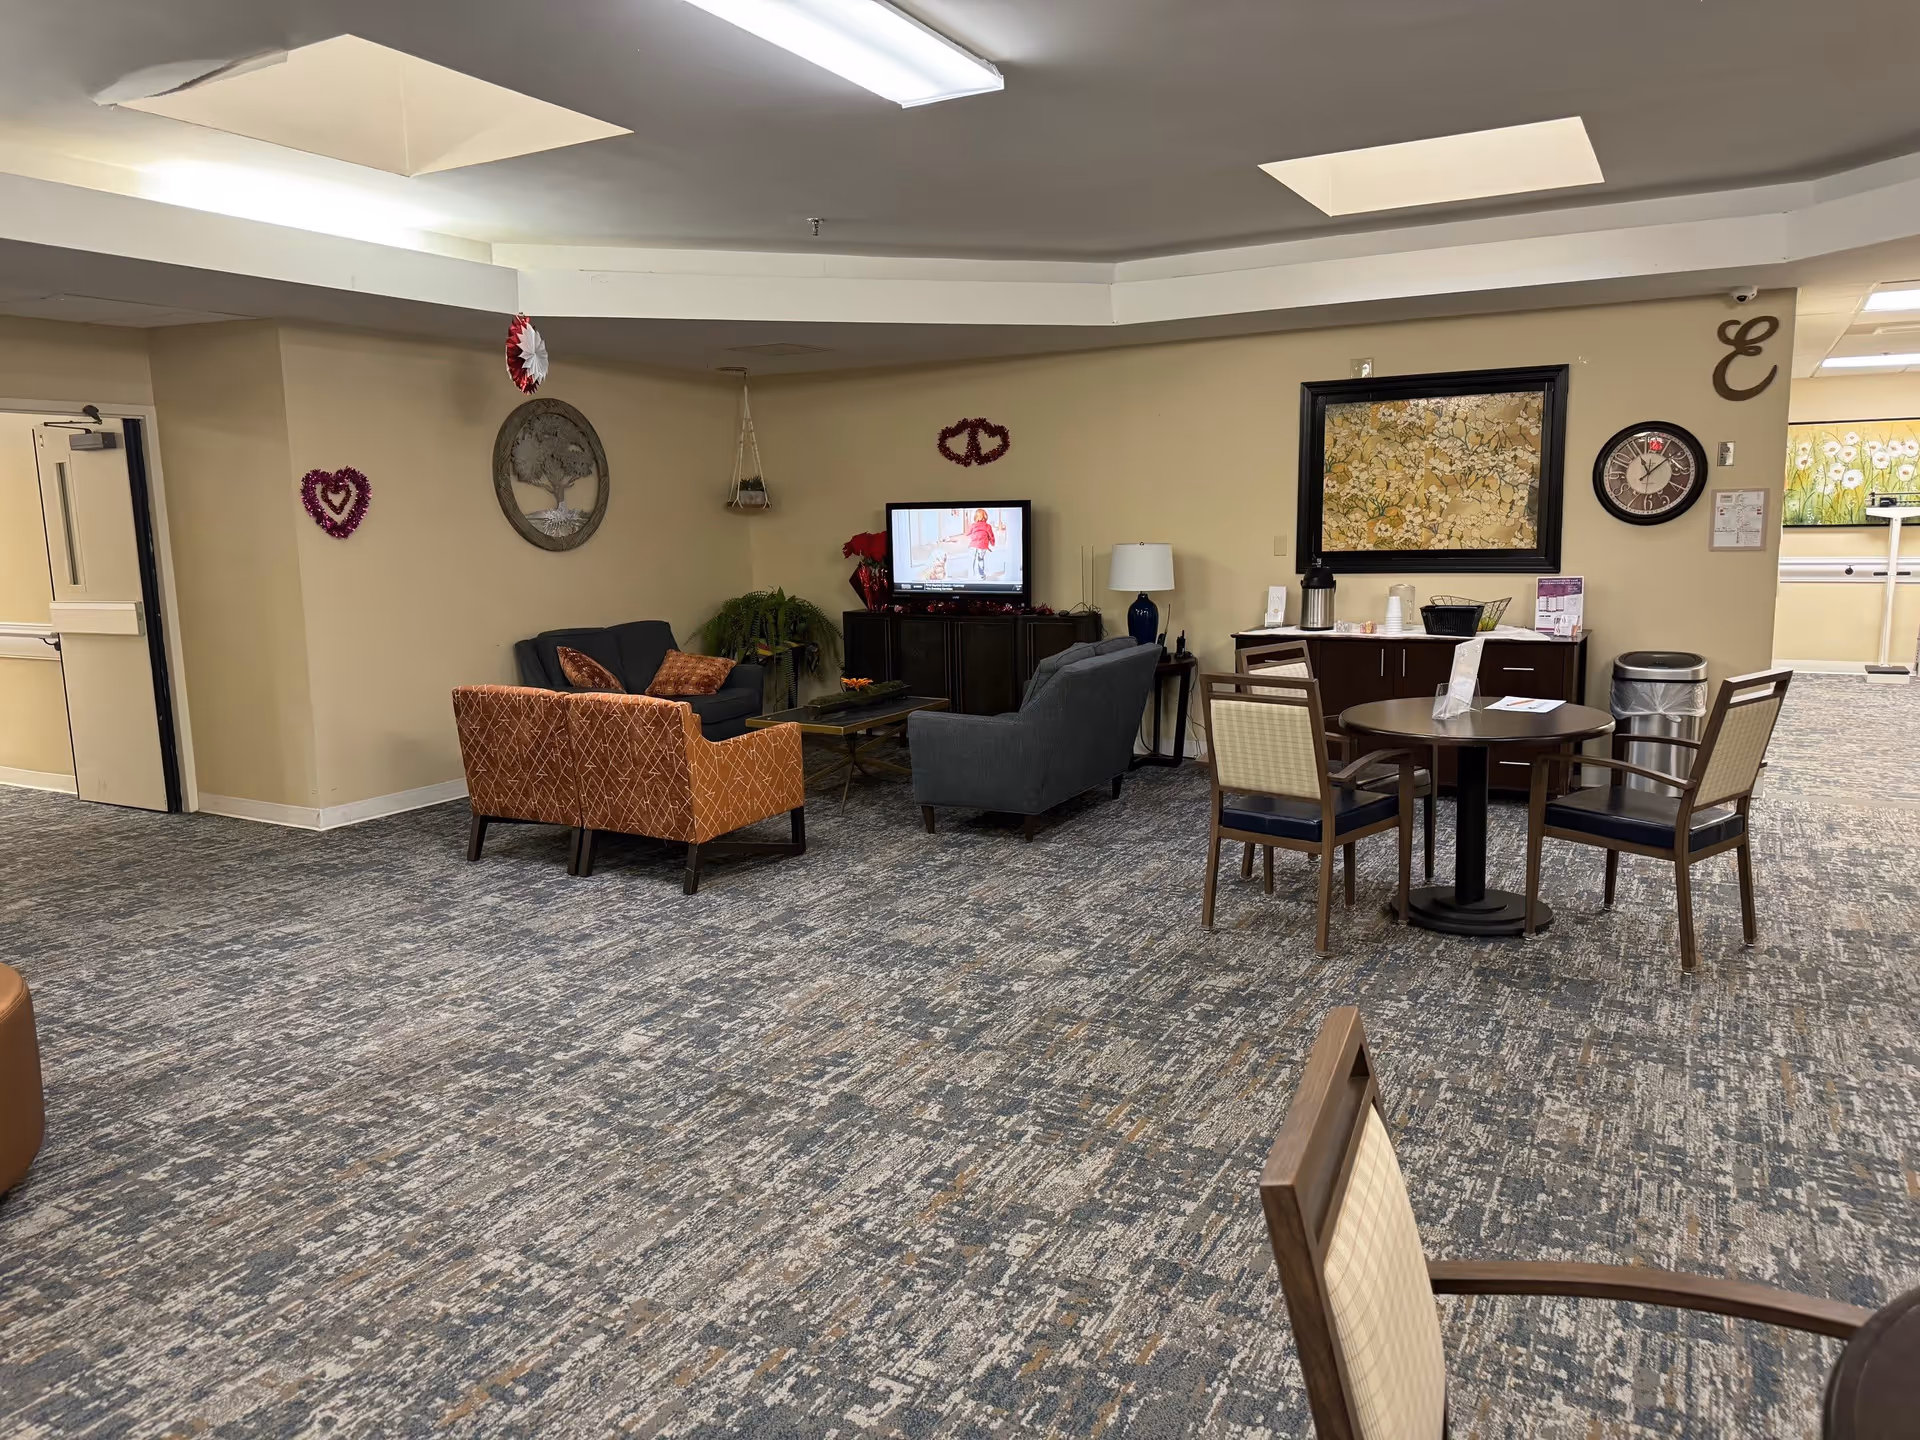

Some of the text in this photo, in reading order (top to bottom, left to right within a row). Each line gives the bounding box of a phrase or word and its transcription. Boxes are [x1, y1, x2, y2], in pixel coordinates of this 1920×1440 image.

[1711, 315, 1780, 402] E
[1626, 440, 1643, 458] 11
[1611, 452, 1634, 469] 10
[1607, 469, 1626, 480] 9
[1613, 482, 1631, 497] 8
[1669, 480, 1686, 493] 4
[1627, 489, 1641, 509] 7
[1643, 494, 1654, 511] 6
[1657, 489, 1670, 506] 5
